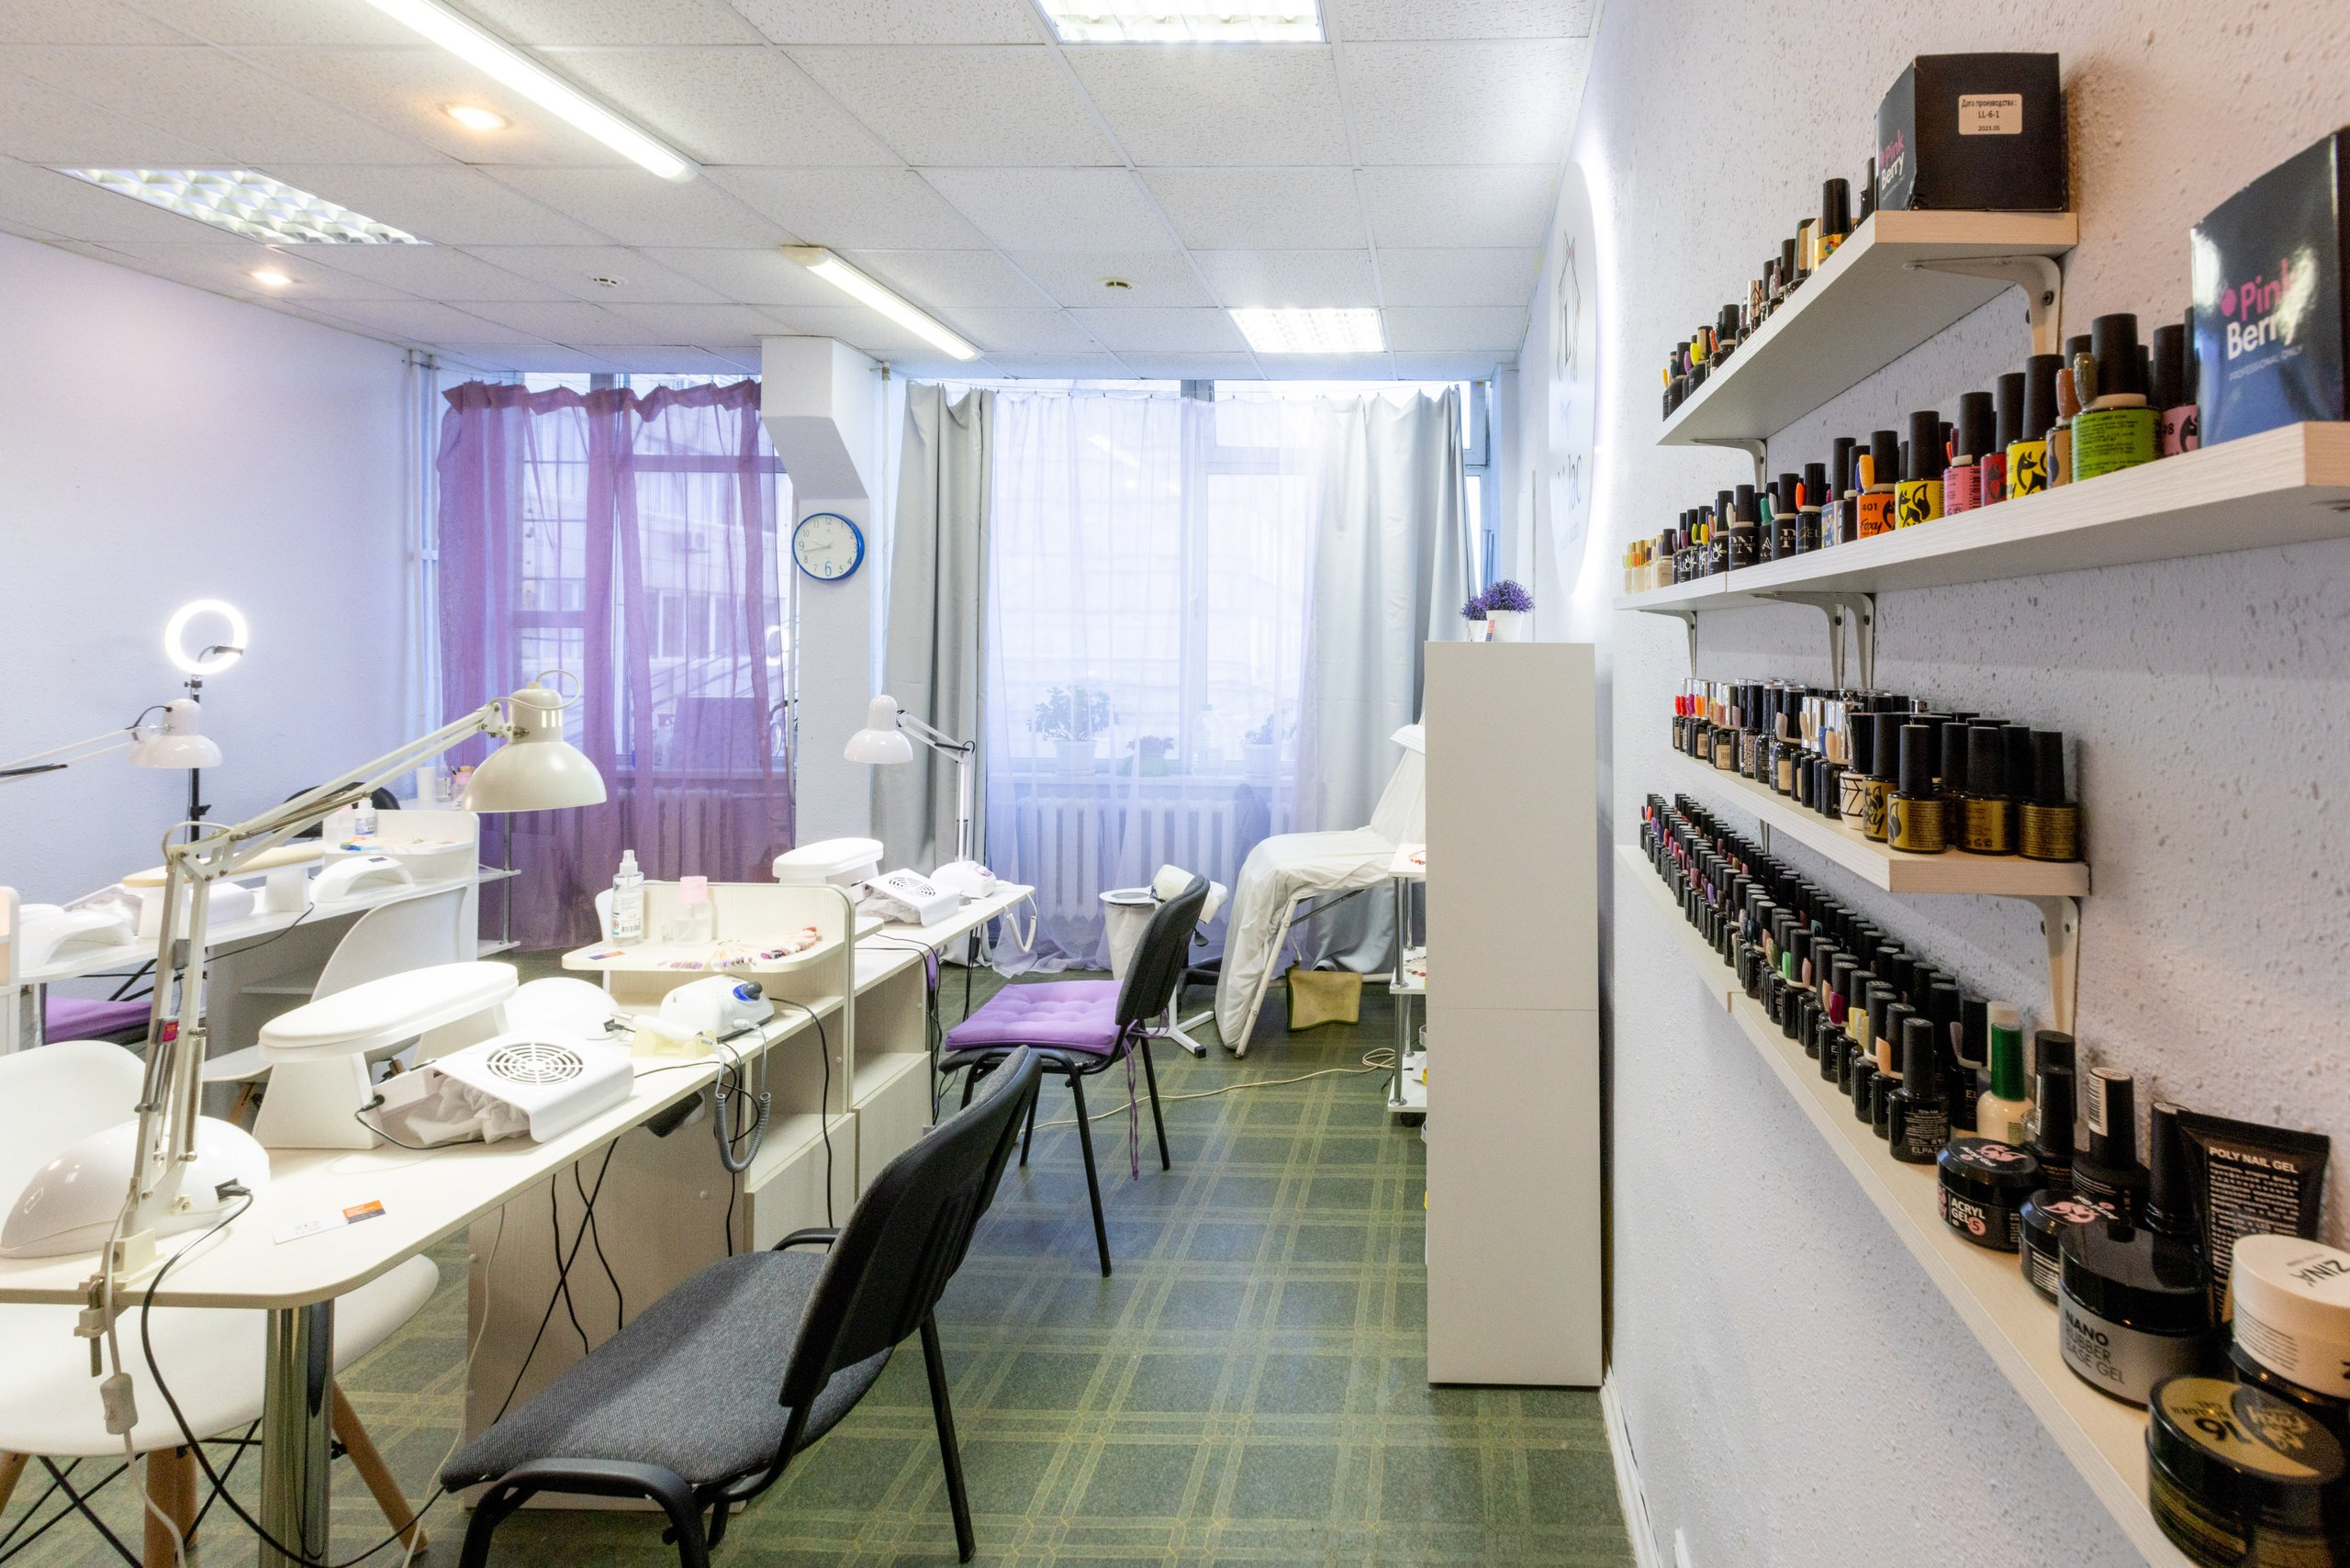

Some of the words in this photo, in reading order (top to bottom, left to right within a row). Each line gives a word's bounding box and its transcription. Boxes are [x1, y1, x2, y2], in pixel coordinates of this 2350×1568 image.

[1962, 99, 1975, 107] Дата
[1978, 110, 1999, 118] LL-6-1
[1885, 128, 1905, 167] Pink
[1882, 151, 1905, 190] Berry
[1862, 502, 1878, 512] 401
[813, 520, 819, 528] 11
[825, 517, 833, 525] 12
[1860, 518, 1883, 535] Foxy
[799, 541, 804, 551] 9
[804, 554, 808, 564] 8
[847, 556, 852, 566] 4
[824, 561, 832, 577] 6
[839, 566, 844, 574] 5
[2209, 1147, 2240, 1162] POLY
[2242, 1155, 2271, 1169] NAIL
[2272, 1160, 2300, 1174] GEL
[1951, 1197, 1986, 1220] ACRYL
[1952, 1208, 1970, 1224] GEL
[2065, 1307, 2109, 1347] NANO
[2065, 1324, 2112, 1365] RUBBER
[2097, 1361, 2126, 1385] GEL
[2194, 1417, 2255, 1445] 16
